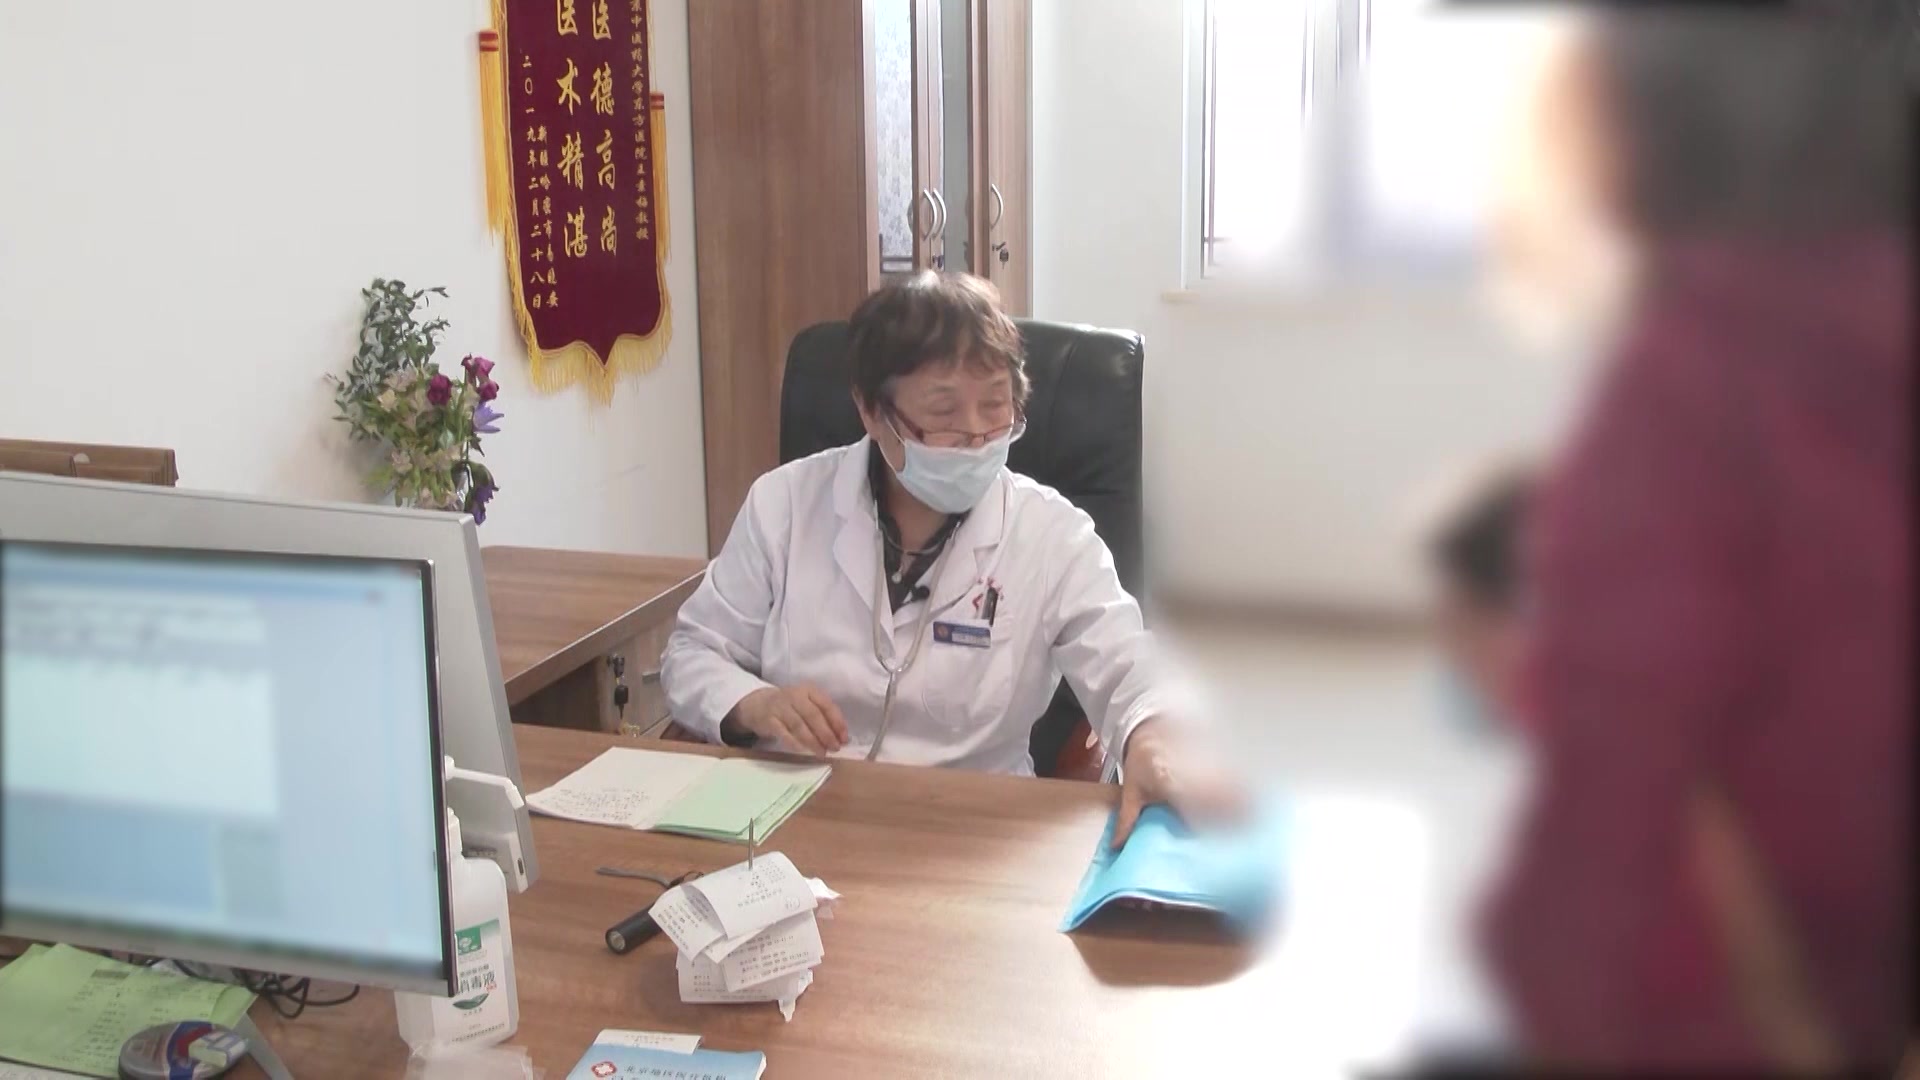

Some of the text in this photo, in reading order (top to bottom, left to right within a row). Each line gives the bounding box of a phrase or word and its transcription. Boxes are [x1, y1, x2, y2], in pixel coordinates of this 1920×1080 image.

[556, 0, 588, 258] 医术精湛
[590, 1, 617, 258] 医德高尚
